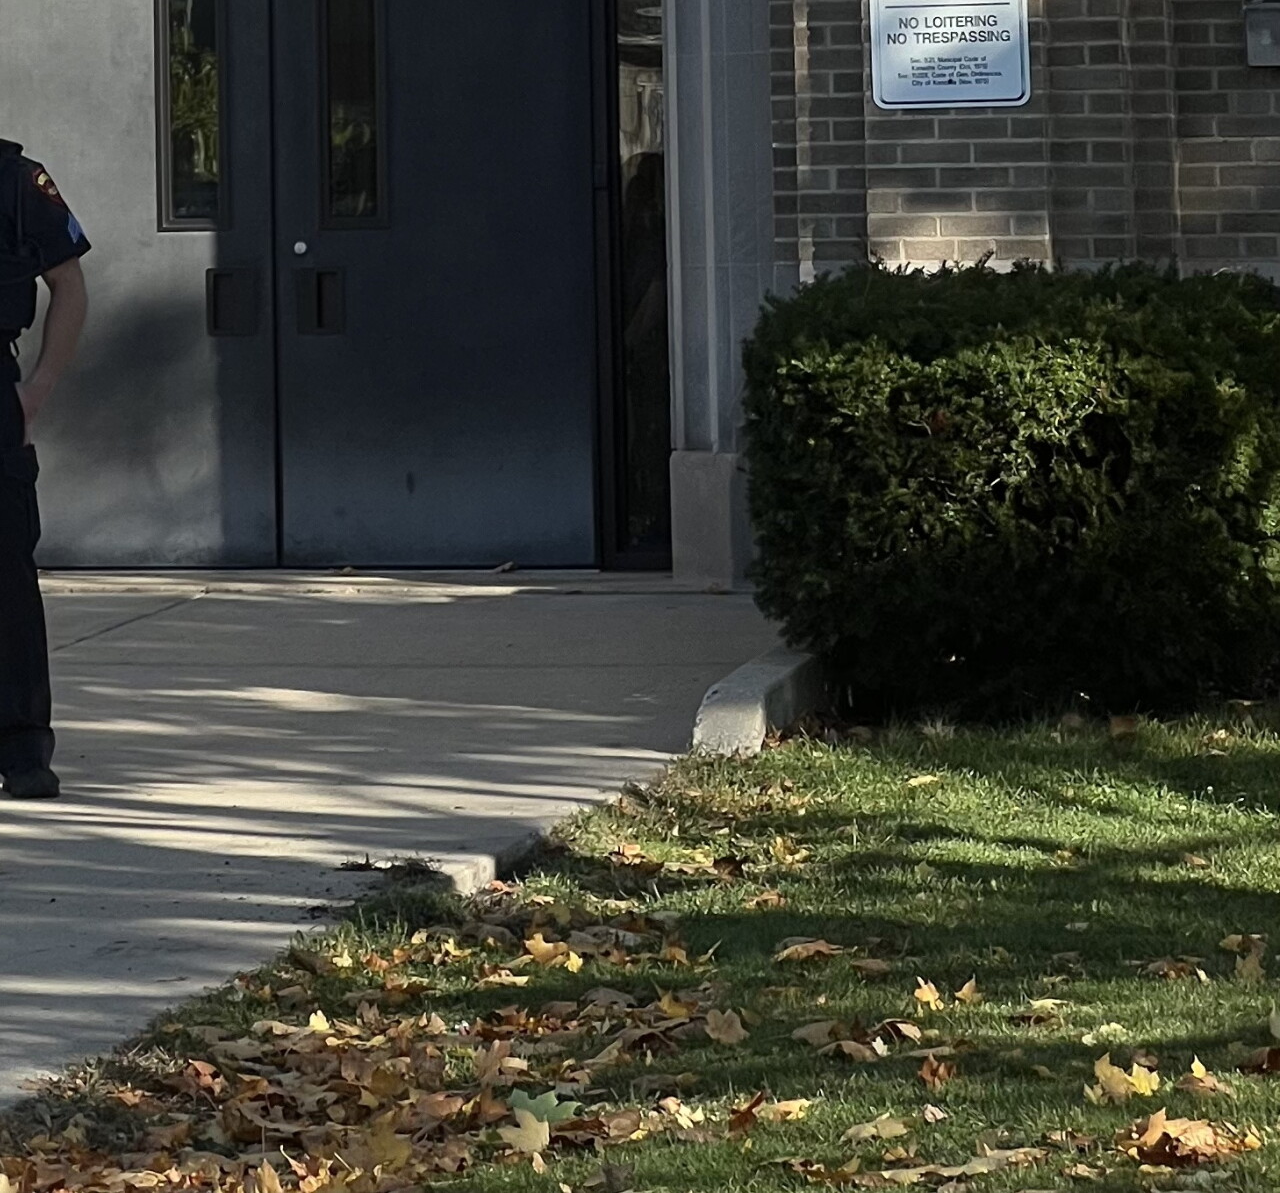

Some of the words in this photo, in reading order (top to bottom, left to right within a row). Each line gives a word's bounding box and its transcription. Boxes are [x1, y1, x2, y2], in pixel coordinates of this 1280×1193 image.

[898, 17, 919, 29] NO
[924, 15, 998, 28] LOITERING
[887, 33, 907, 45] NO
[914, 30, 1011, 44] TRESPASSING
